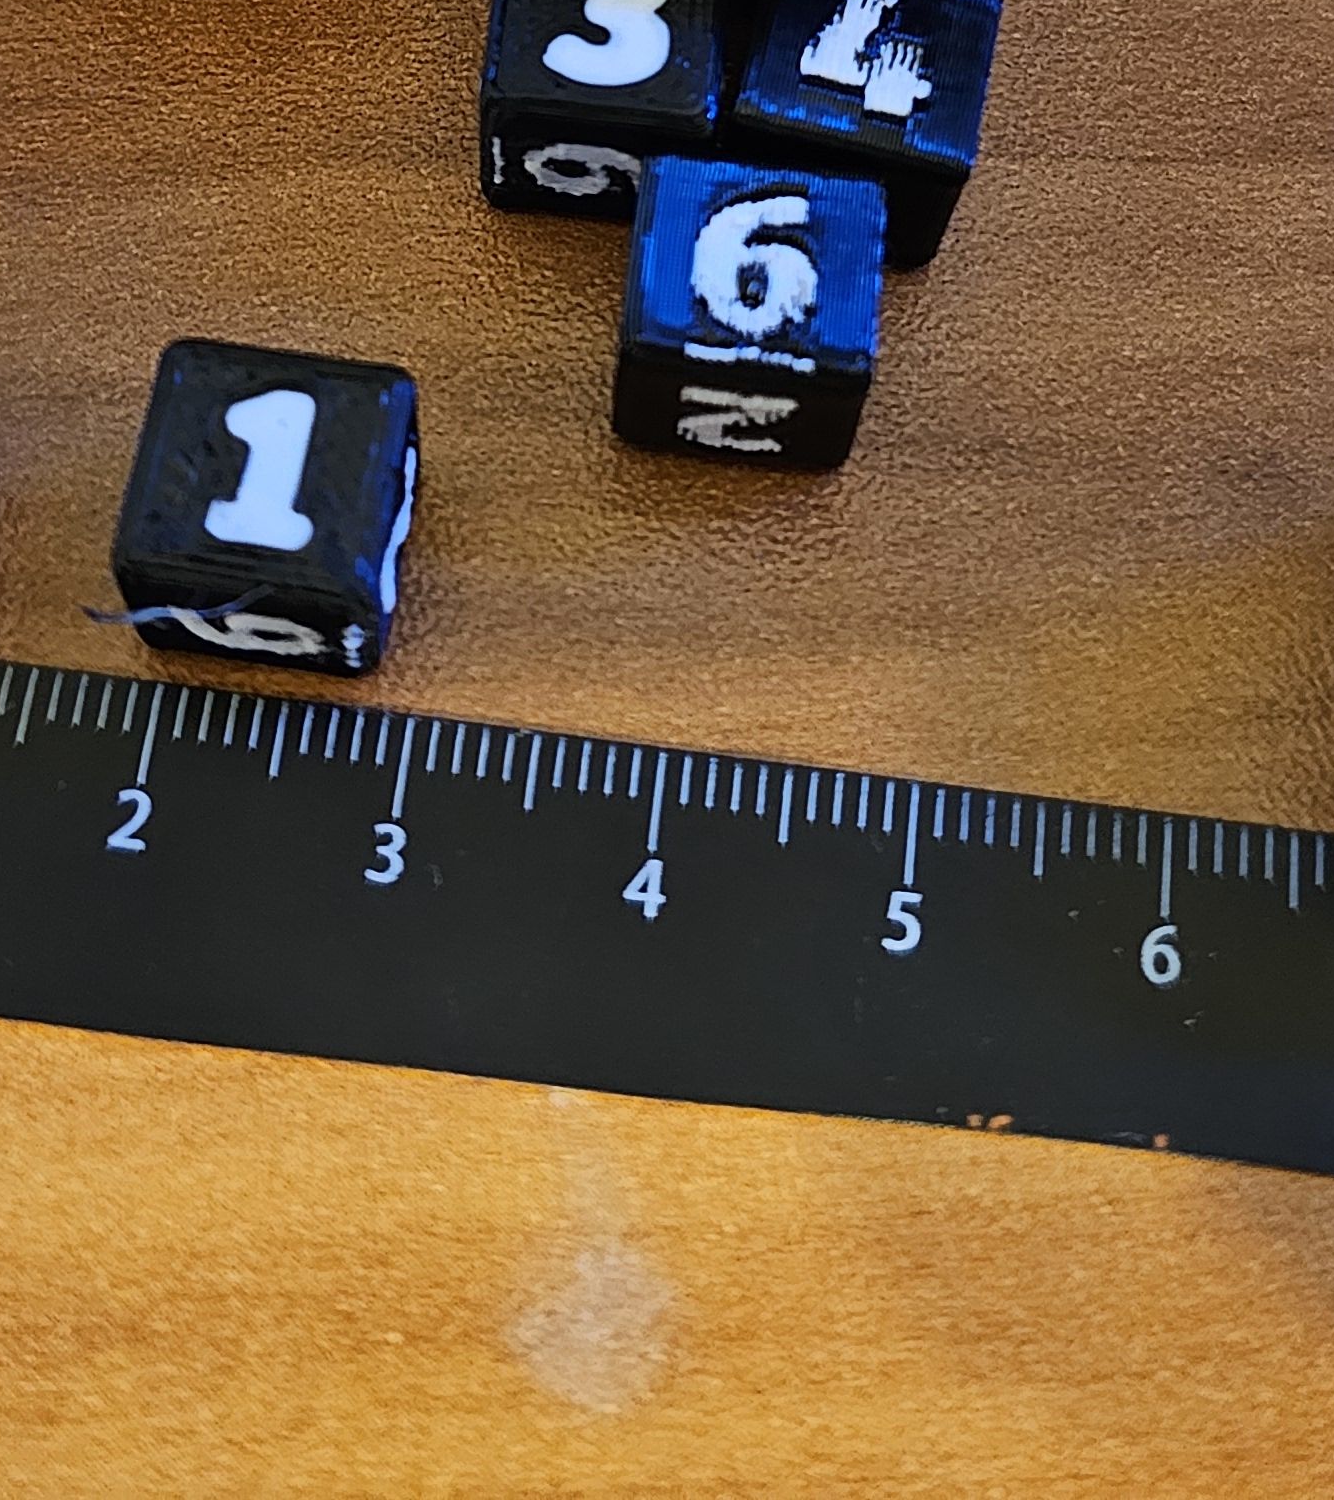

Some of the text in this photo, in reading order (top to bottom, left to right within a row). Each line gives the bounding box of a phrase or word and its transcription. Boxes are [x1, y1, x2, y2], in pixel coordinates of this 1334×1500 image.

[691, 196, 819, 341] 6
[204, 389, 316, 551] 1
[105, 788, 153, 854] 2
[362, 823, 408, 886] 3
[621, 858, 668, 920] 4
[881, 891, 924, 954] 5
[1139, 924, 1182, 987] 6
